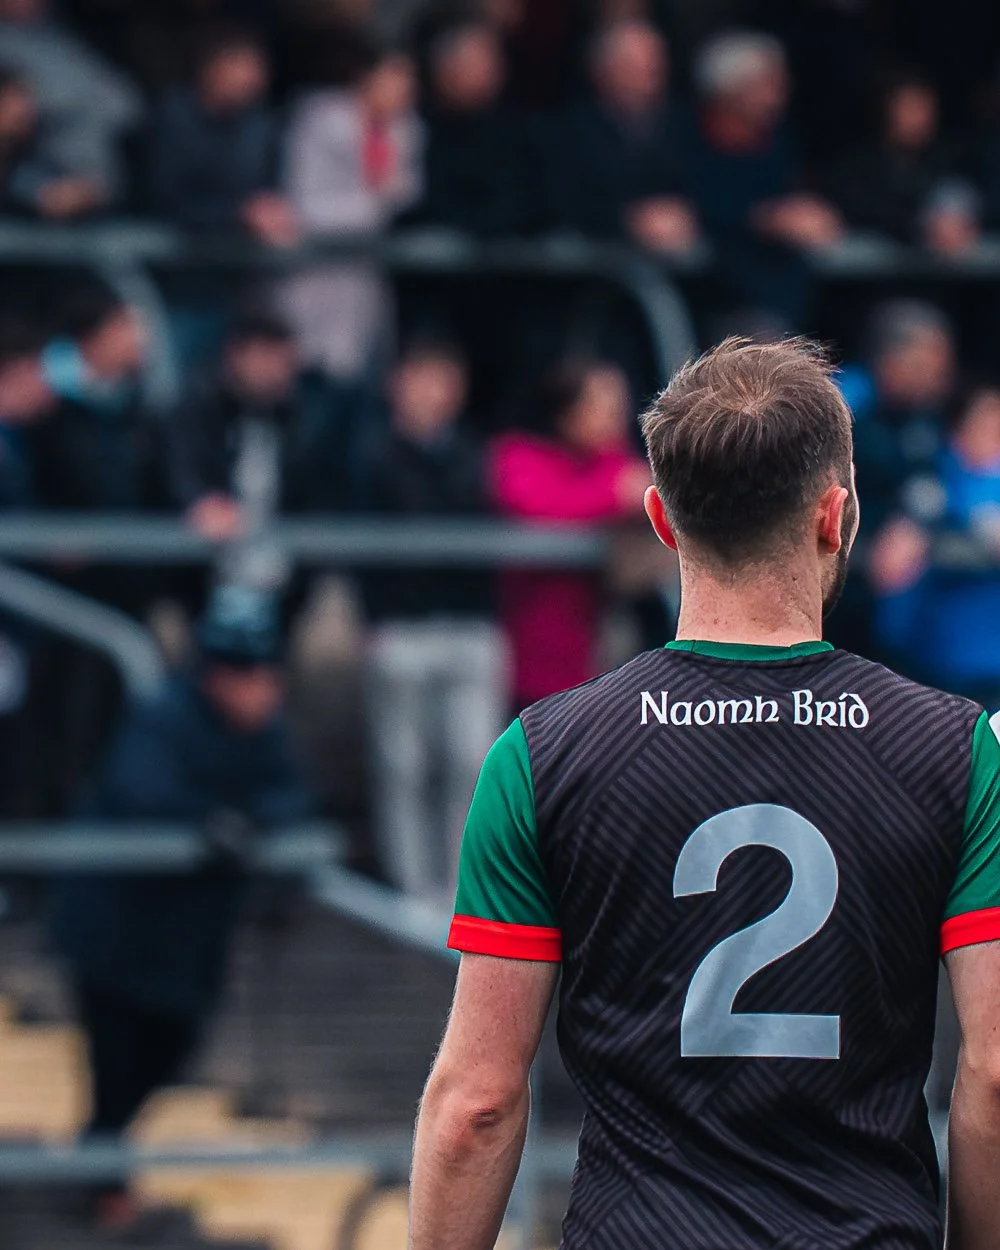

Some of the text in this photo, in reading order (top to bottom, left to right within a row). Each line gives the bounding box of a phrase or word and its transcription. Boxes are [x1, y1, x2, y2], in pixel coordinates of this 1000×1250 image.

[640, 689, 869, 729] Naomh Bríd
[673, 803, 840, 1059] 2
